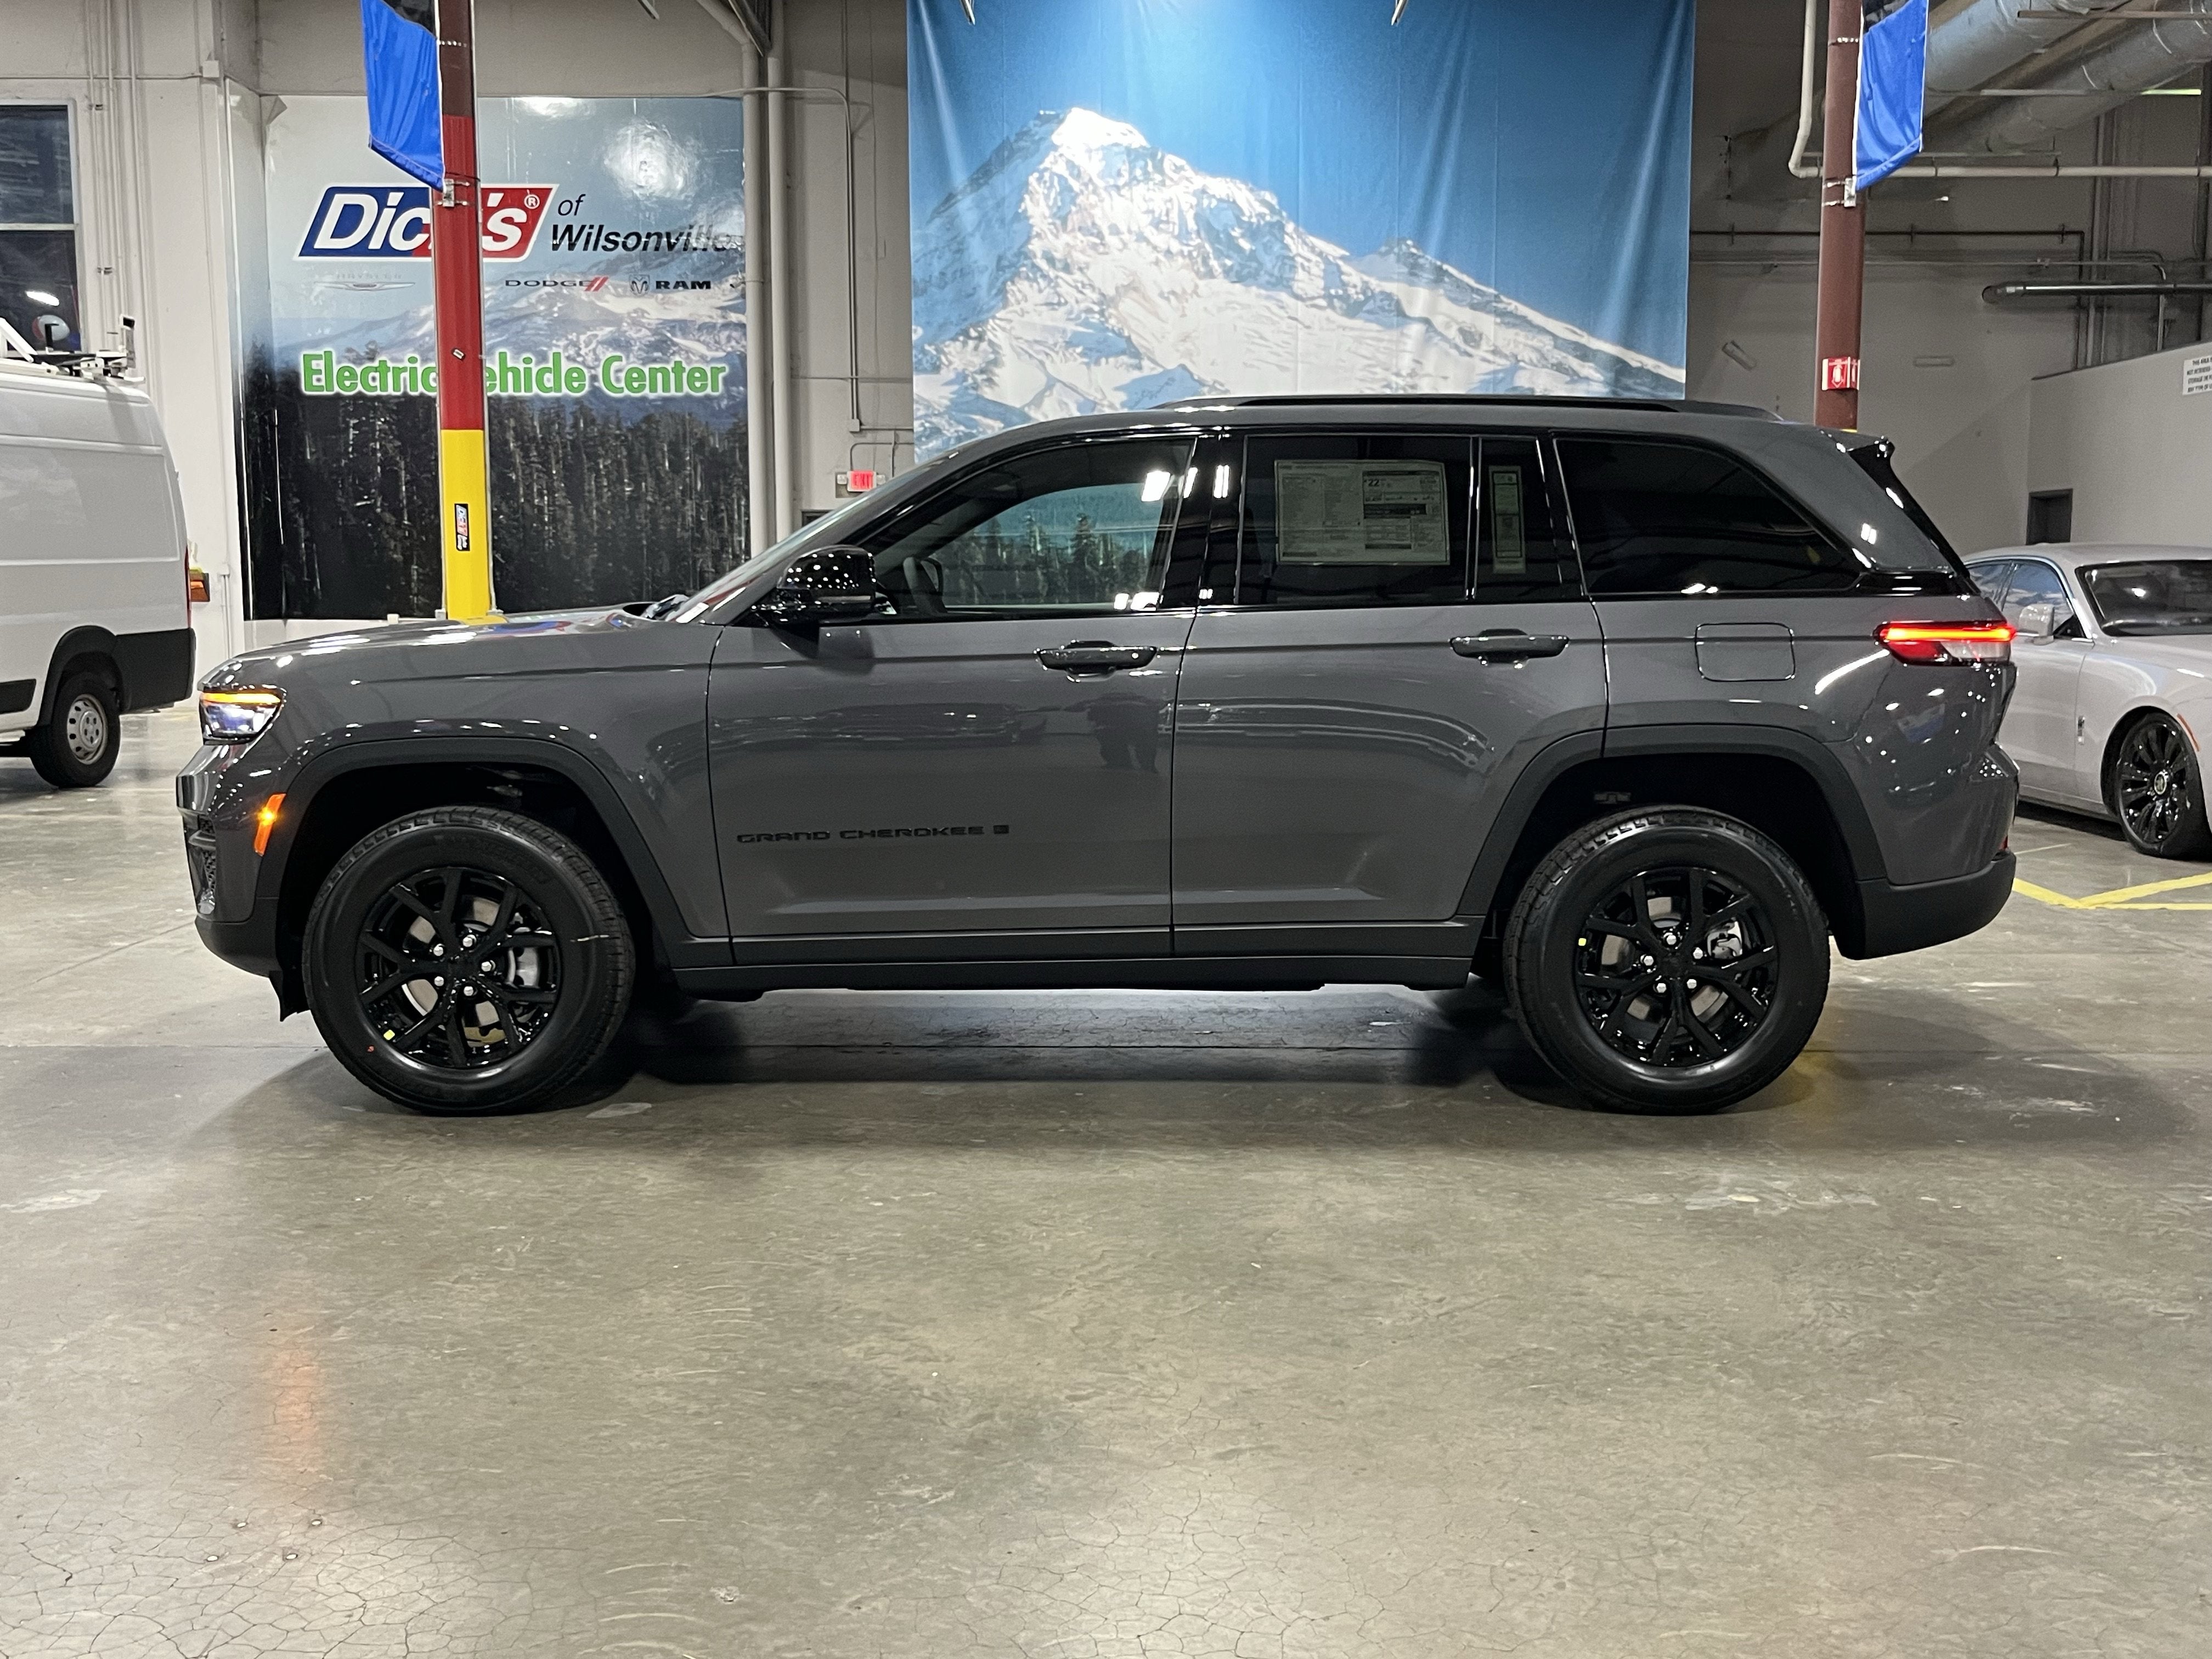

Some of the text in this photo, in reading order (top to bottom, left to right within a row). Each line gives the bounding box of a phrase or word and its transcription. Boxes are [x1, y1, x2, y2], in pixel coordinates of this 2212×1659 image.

[313, 191, 586, 252] Dic's of
[656, 280, 712, 290] RAM
[303, 351, 726, 394] Electric ehicle Center
[853, 473, 873, 489] EXIT
[737, 826, 984, 843] GRAND CHEROKEE
